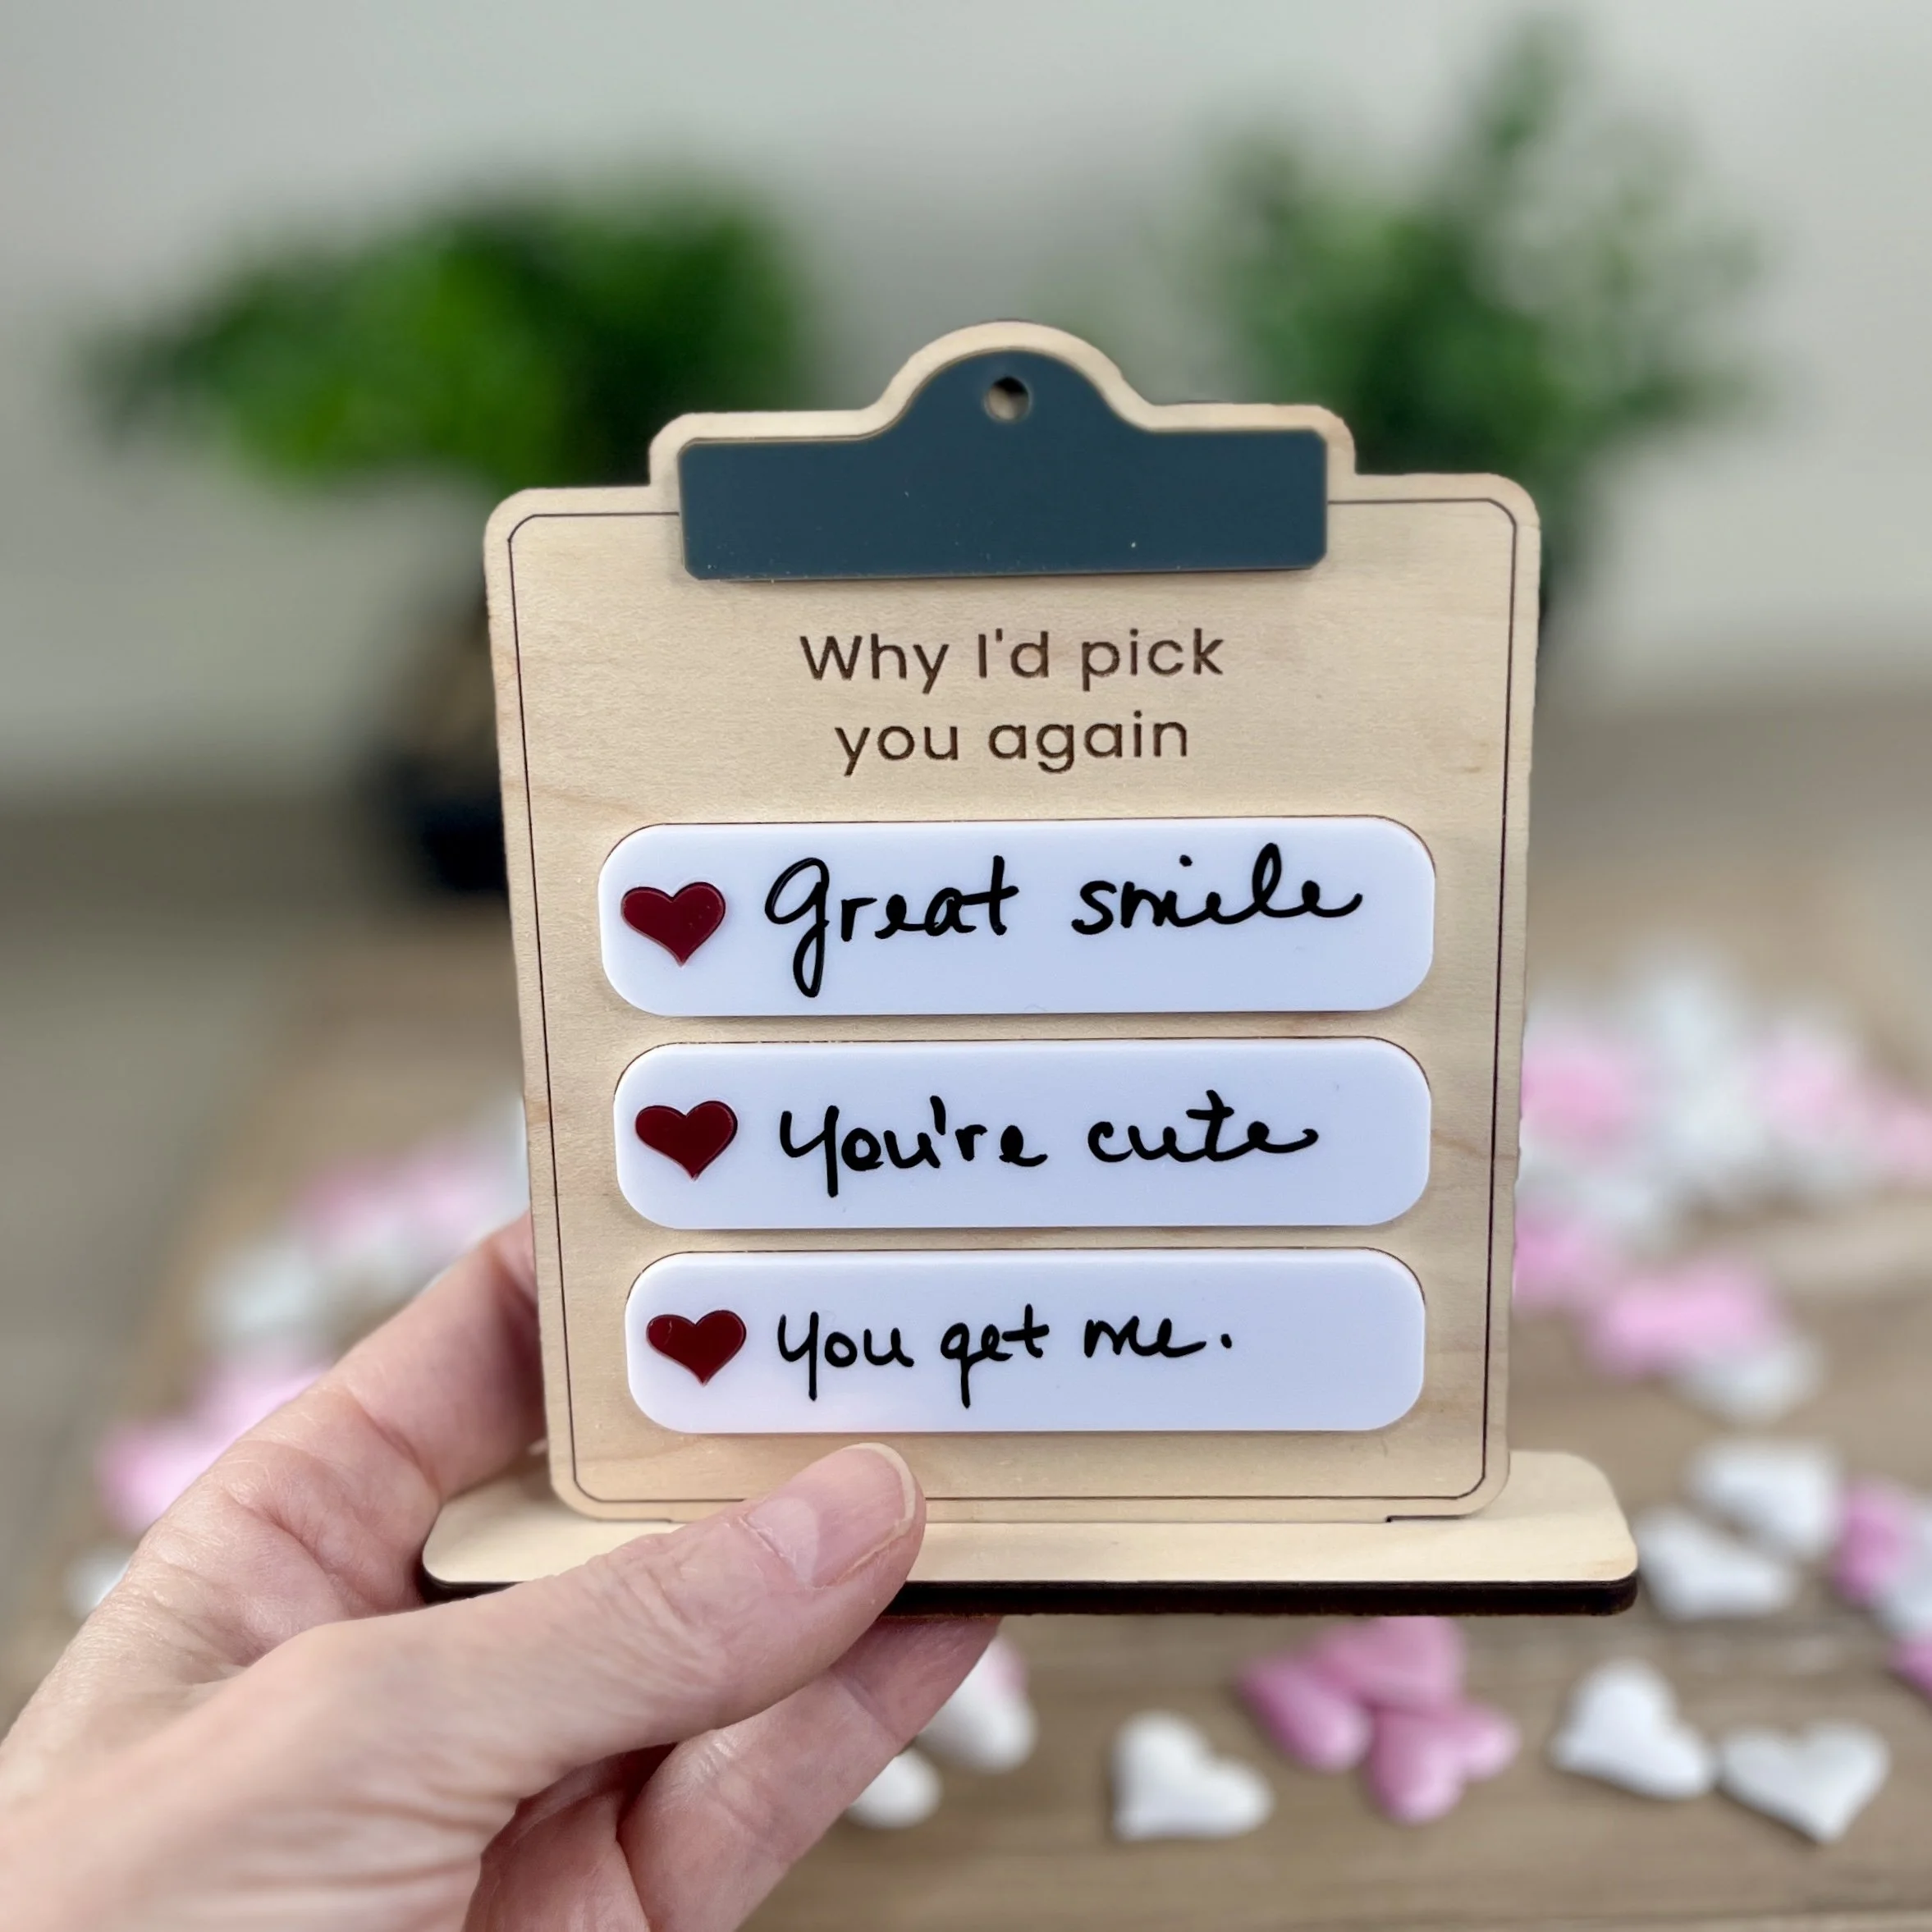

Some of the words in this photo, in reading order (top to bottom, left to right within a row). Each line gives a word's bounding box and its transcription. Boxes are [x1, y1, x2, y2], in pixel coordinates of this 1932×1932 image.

[799, 633, 950, 694] Why
[977, 628, 1049, 679] I'd
[1081, 627, 1224, 692] pick
[834, 723, 959, 776] you
[988, 710, 1188, 774] again
[1071, 842, 1363, 936] smile
[1087, 1089, 1320, 1163] cute
[940, 1303, 1051, 1409] get
[1083, 1315, 1233, 1358] me.
